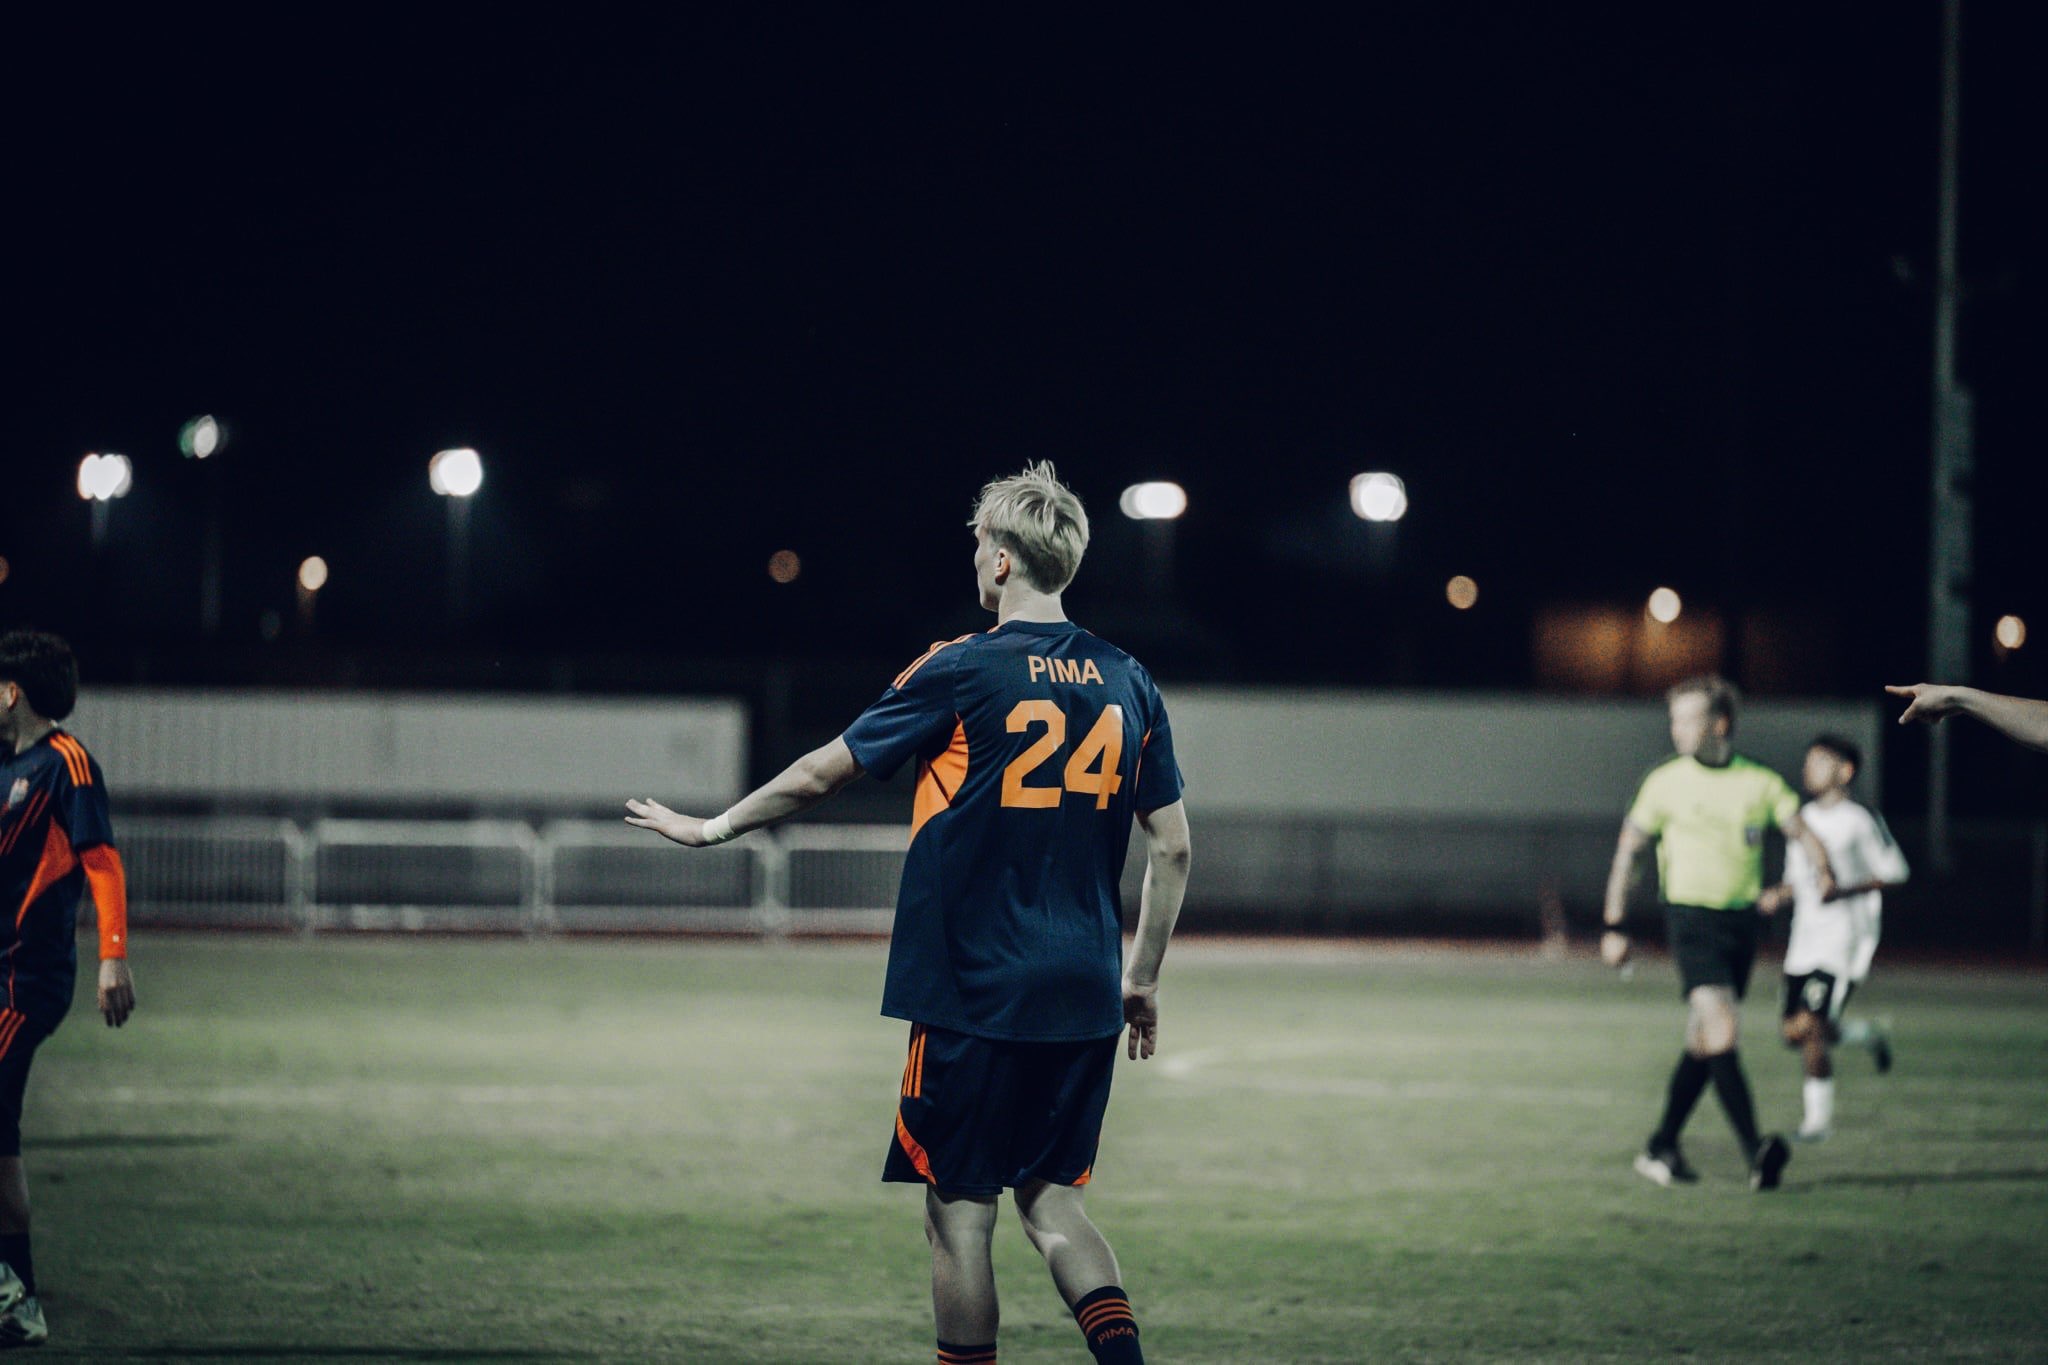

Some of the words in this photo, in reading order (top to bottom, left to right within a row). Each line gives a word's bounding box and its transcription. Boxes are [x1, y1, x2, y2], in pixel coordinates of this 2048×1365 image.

[1027, 655, 1104, 685] PIMA
[1000, 699, 1123, 810] 24
[1097, 1326, 1136, 1345] PIMA
